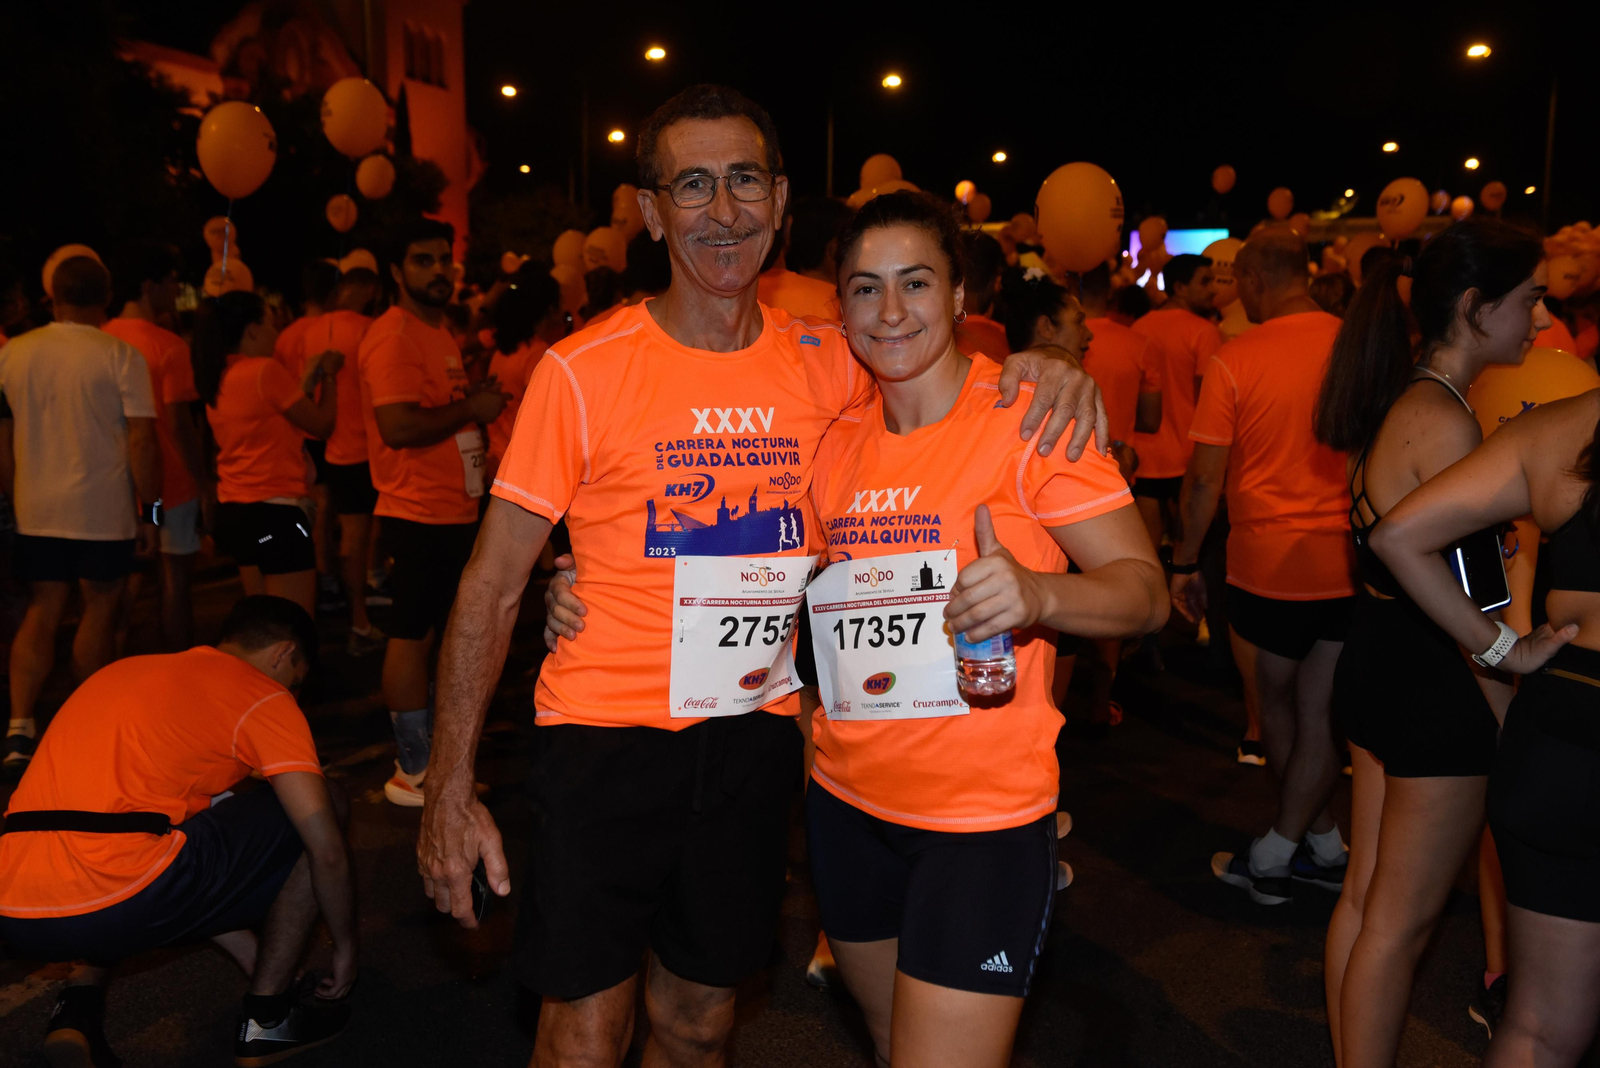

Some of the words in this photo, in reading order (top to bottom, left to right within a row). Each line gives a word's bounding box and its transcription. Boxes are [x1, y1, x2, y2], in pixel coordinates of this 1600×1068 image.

[690, 407, 775, 434] XXXV
[654, 438, 726, 452] CARRERA
[732, 437, 800, 449] NOCTURNA
[656, 453, 664, 470] DEL
[667, 451, 801, 468] GUADALQUIVIR
[846, 485, 922, 514] XXXV
[826, 516, 865, 531] CARRERA
[870, 514, 942, 526] NOCTURNA
[830, 528, 941, 547] GUADALQUIVIR
[648, 547, 677, 556] 2023
[883, 596, 923, 605] GUADALQUIVIR
[833, 612, 926, 650] 17357
[913, 698, 959, 709] Cruzcampo
[980, 963, 1013, 973] adidas
